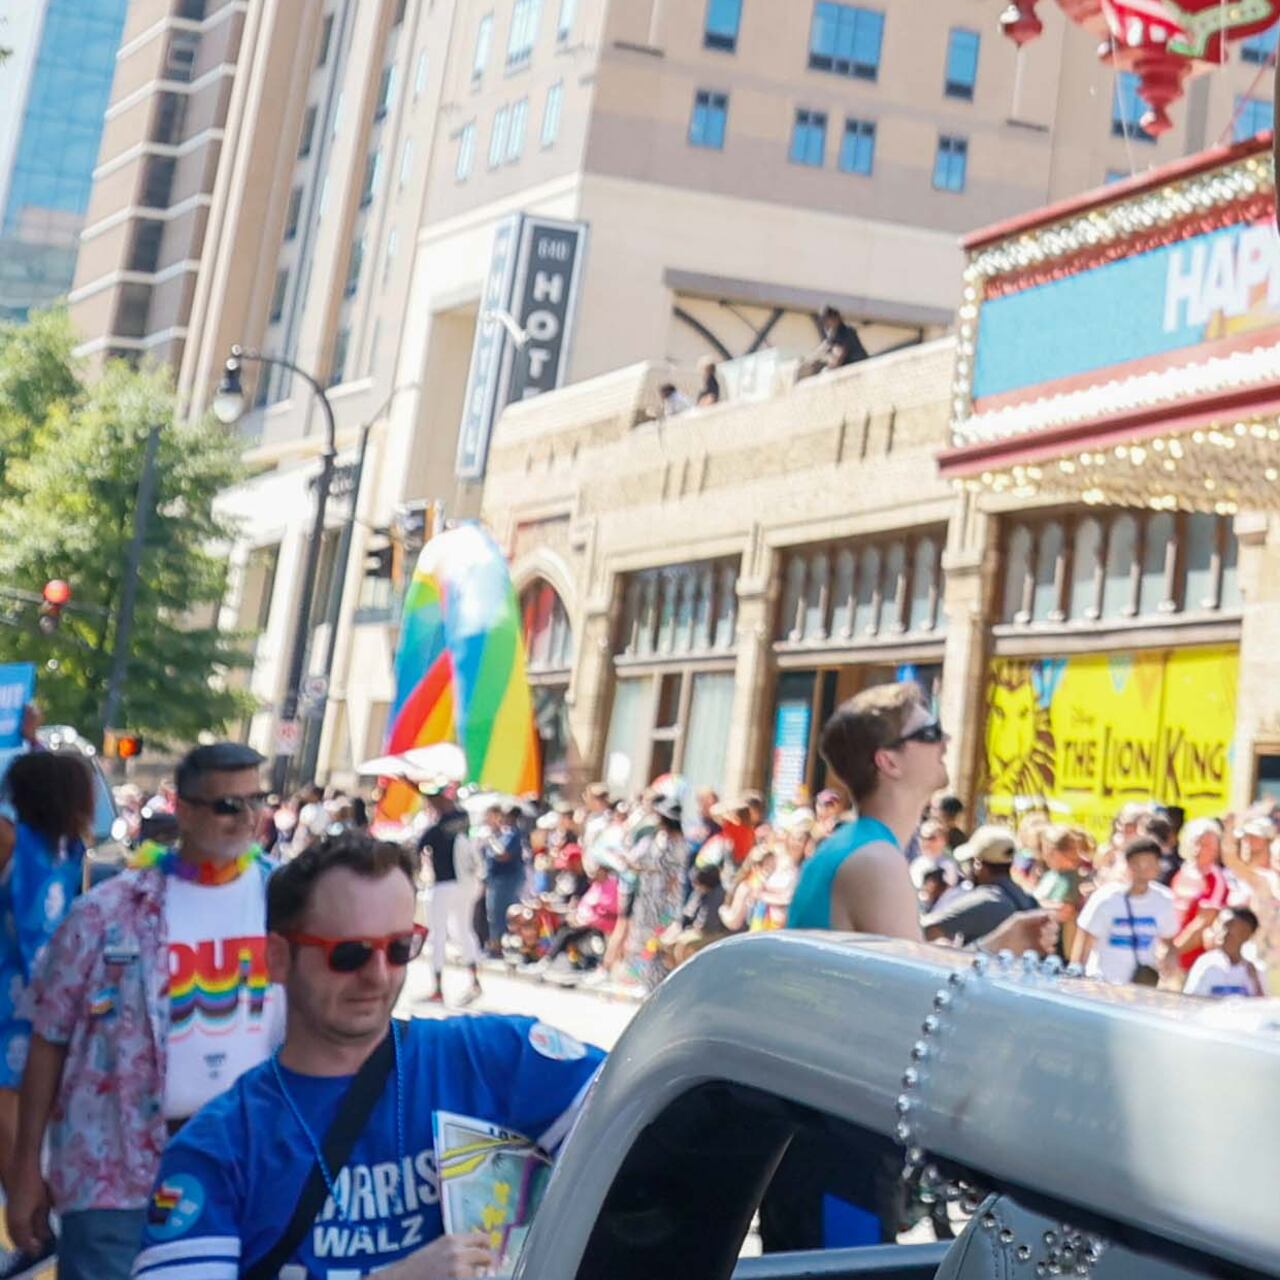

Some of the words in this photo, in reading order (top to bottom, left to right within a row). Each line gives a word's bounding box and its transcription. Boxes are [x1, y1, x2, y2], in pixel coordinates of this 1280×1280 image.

[523, 271, 565, 400] HOT
[1063, 740, 1097, 780] THE
[1102, 725, 1156, 797] LION
[1161, 726, 1227, 799] KING
[312, 1150, 440, 1221] ARRIS
[313, 1215, 424, 1258] WALZ
